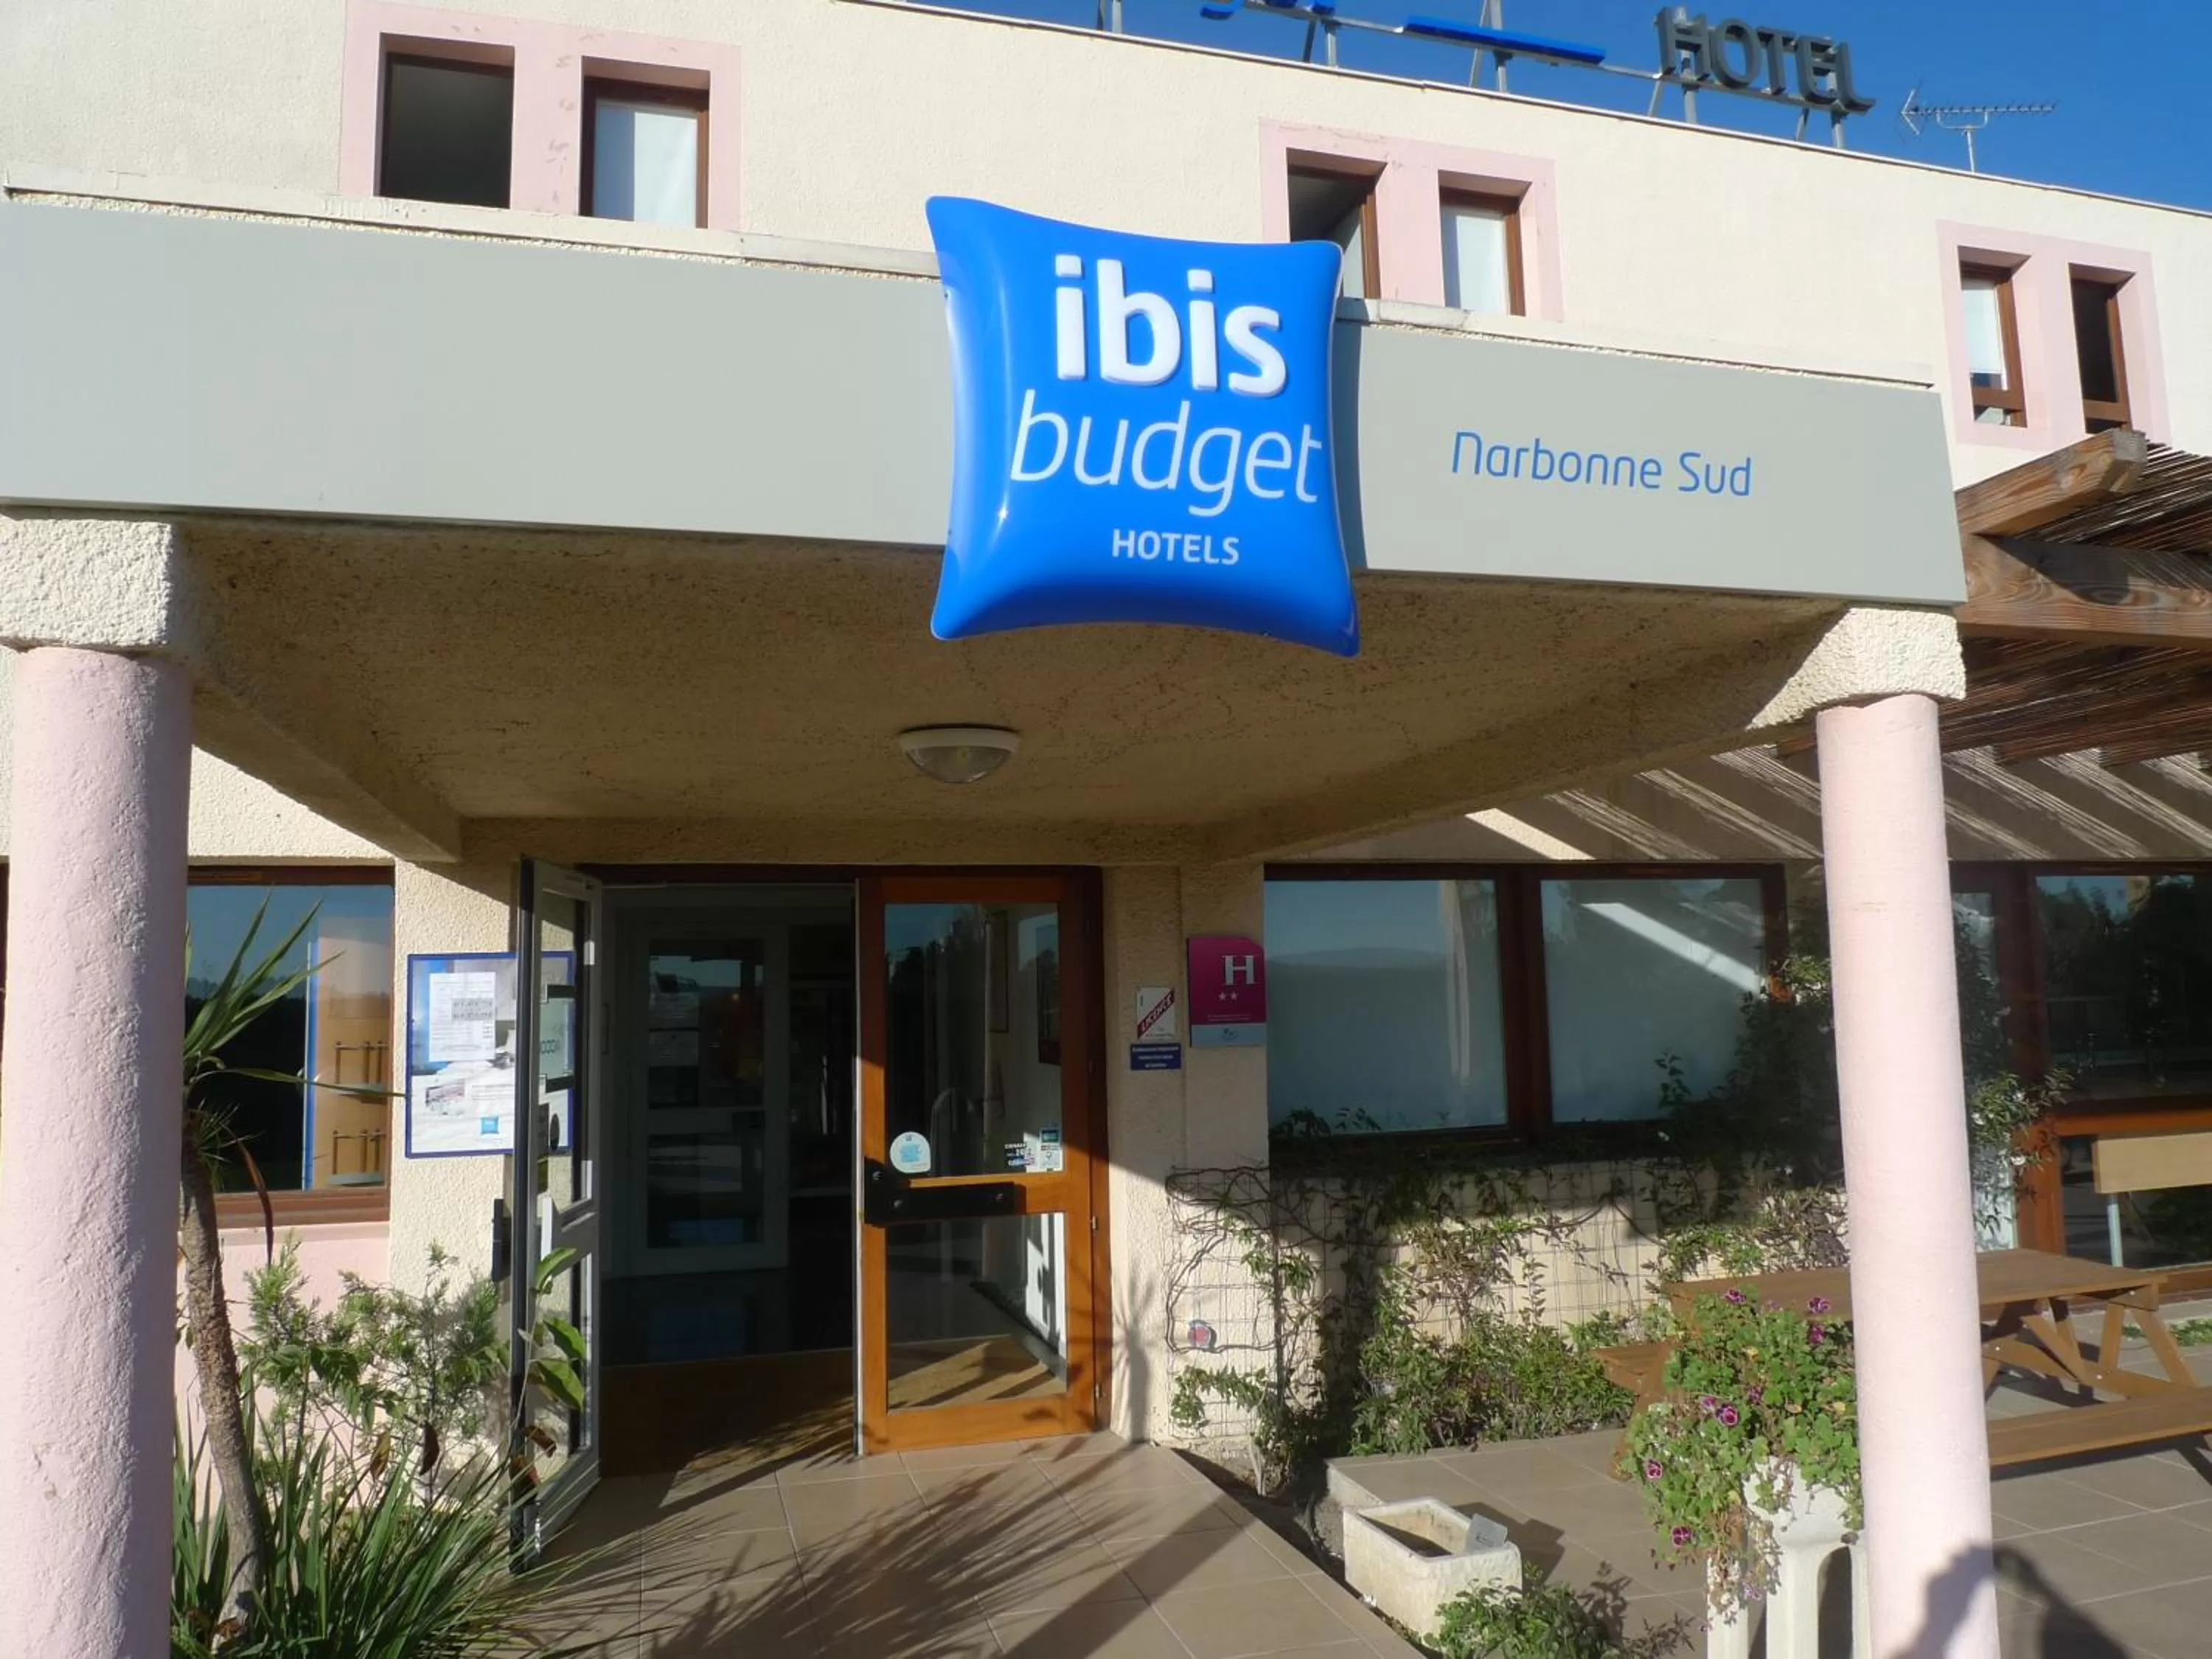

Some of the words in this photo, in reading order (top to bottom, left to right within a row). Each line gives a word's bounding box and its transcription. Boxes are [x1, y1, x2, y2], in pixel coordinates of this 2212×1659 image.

[1654, 7, 1877, 114] HOTEL
[1054, 254, 1287, 398] ibis
[1009, 389, 1323, 518] budget
[1451, 431, 1663, 490] Narbonne
[1677, 451, 1752, 497] Sud
[1111, 529, 1240, 566] HOTELS
[1222, 955, 1257, 986] H
